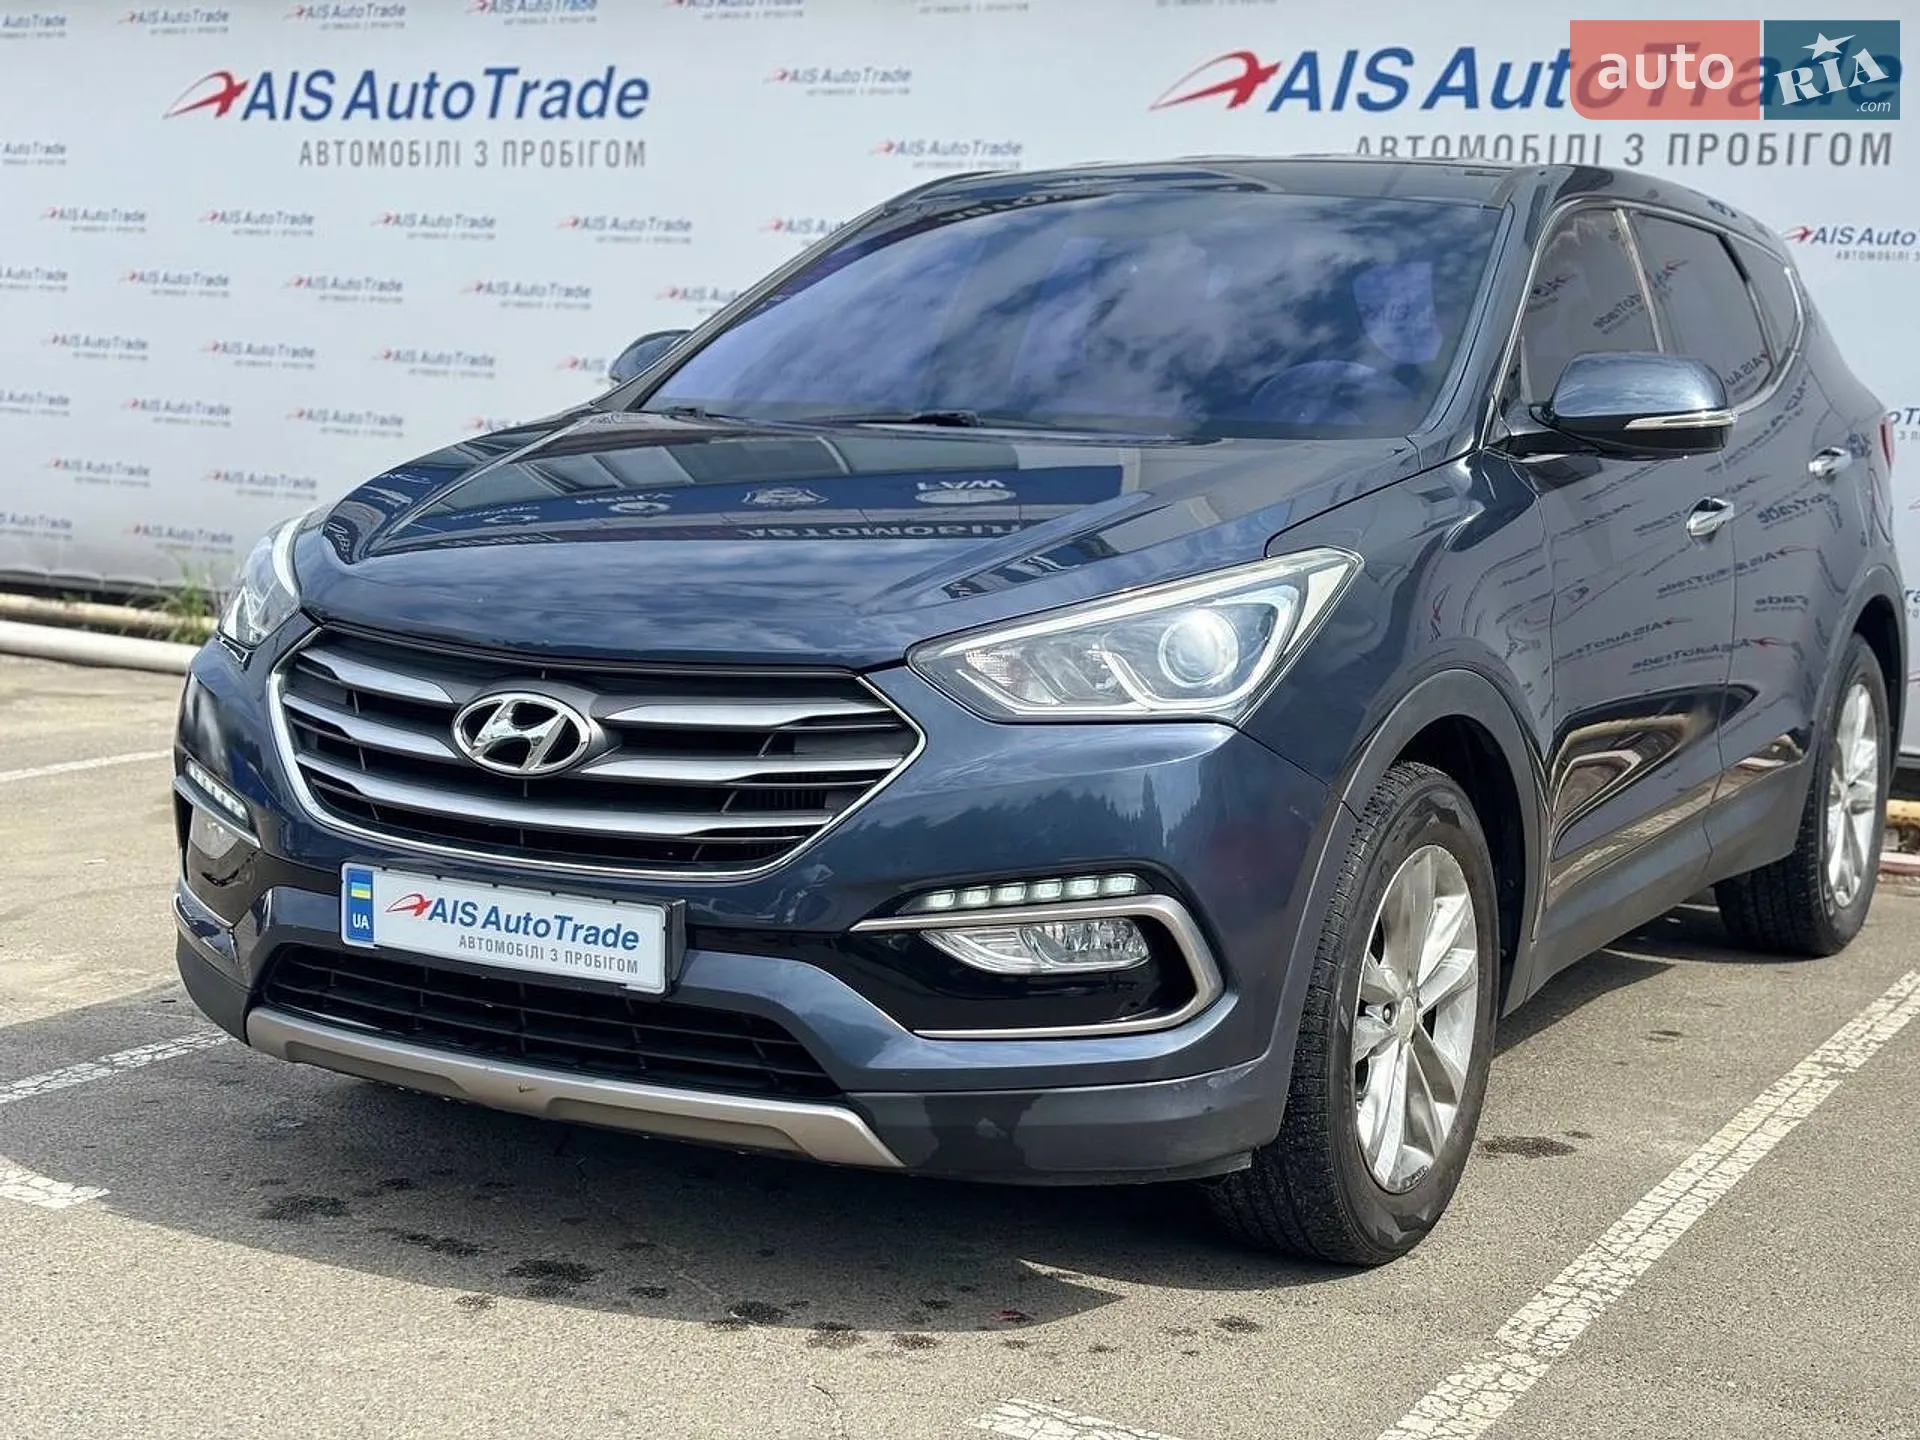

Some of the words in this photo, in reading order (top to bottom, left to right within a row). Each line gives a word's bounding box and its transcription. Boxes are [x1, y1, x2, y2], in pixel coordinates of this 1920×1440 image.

[306, 4, 330, 20] AIS
[331, 3, 406, 19] AutoTrade
[789, 67, 818, 84] AIS
[821, 66, 912, 83] AutoTrade
[1266, 47, 1414, 112] AIS
[1419, 38, 1903, 110] AutoTrade
[242, 70, 336, 121] AIS
[342, 65, 650, 121] AutoTrade
[299, 139, 461, 168] АВТОМОБІЛІ
[503, 139, 646, 168] ПРОБІГОМ
[896, 140, 926, 156] AIS
[927, 139, 1023, 156] AutoTrade
[1667, 131, 1892, 166] ПРОБІГОМ
[219, 209, 243, 225] AIS
[244, 209, 314, 226] AutoTrade
[392, 213, 417, 228] AIS
[419, 212, 496, 229] AutoTrade
[580, 215, 606, 231] AIS
[610, 215, 692, 231] AutoTrade
[1811, 226, 1855, 245] AIS
[352, 912, 370, 930] UA
[428, 898, 479, 927] AIS
[481, 909, 640, 951] AutoTrade
[458, 934, 545, 961] АВТОМОБІЛІ
[564, 950, 639, 975] ПРОБІГОМ
